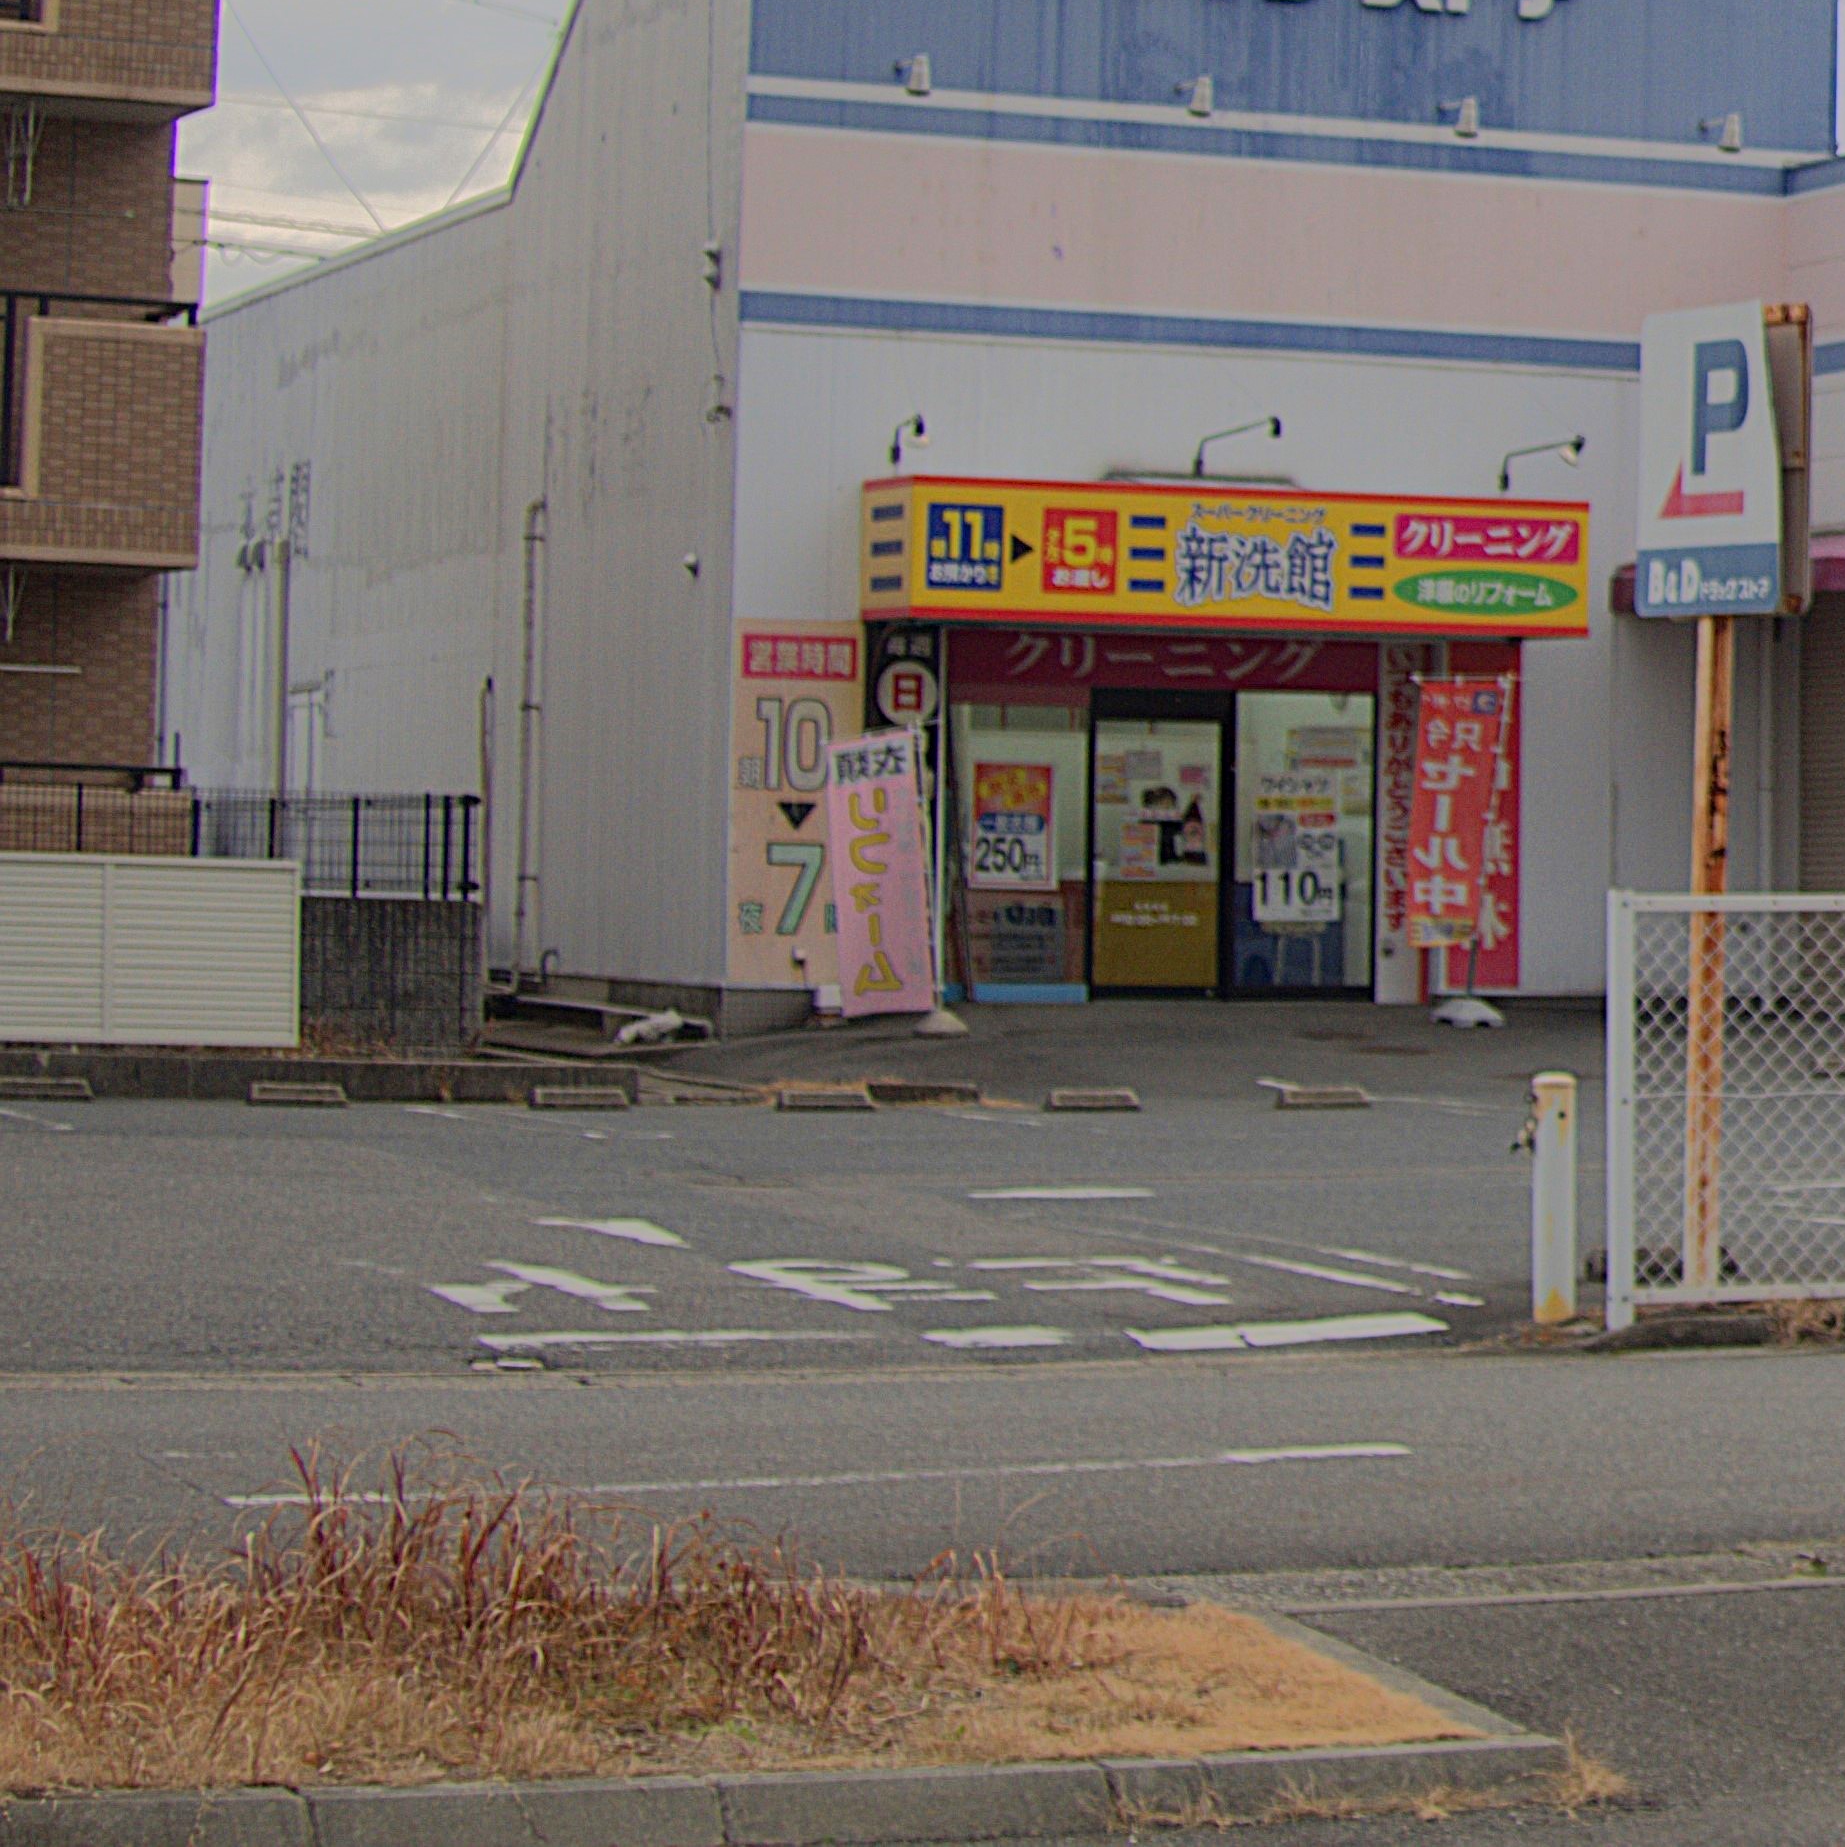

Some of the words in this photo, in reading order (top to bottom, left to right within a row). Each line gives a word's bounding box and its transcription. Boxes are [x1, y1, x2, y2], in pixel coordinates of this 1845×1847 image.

[1692, 338, 1749, 476] P
[1191, 502, 1328, 524] スーパークリーニング
[1400, 518, 1575, 561] クリーニング
[1174, 521, 1338, 611] 新洗館
[1006, 632, 1326, 682] クリーニング
